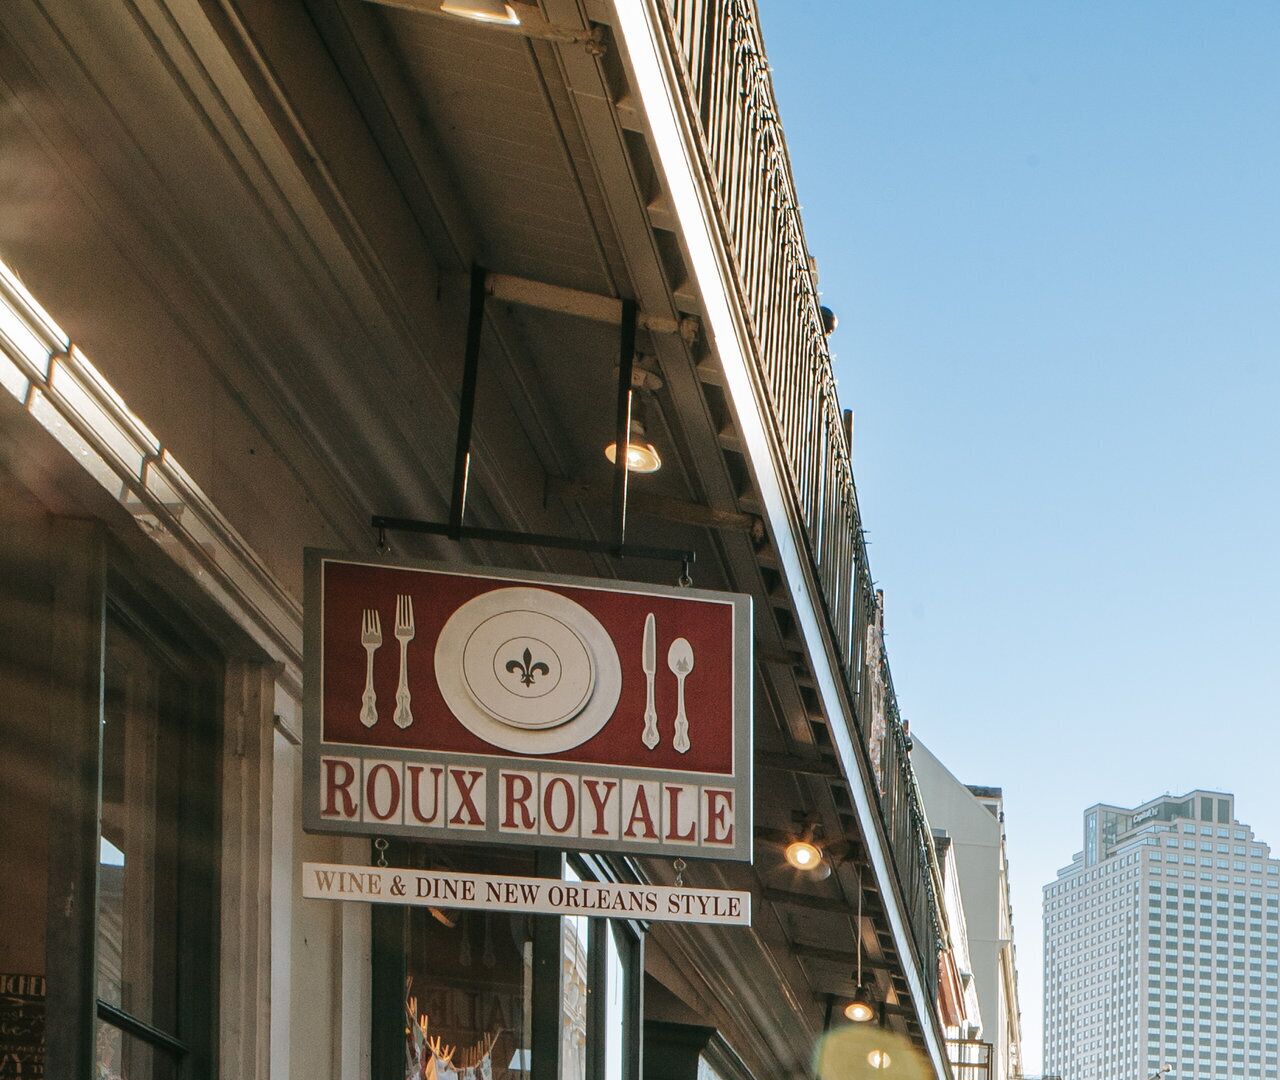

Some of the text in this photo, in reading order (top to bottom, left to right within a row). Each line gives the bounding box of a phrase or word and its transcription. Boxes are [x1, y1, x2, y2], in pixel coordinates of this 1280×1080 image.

[321, 759, 735, 845] ROUX ROYALE
[314, 869, 741, 918] WINE & DINE NEW ORLEANS STYLE
